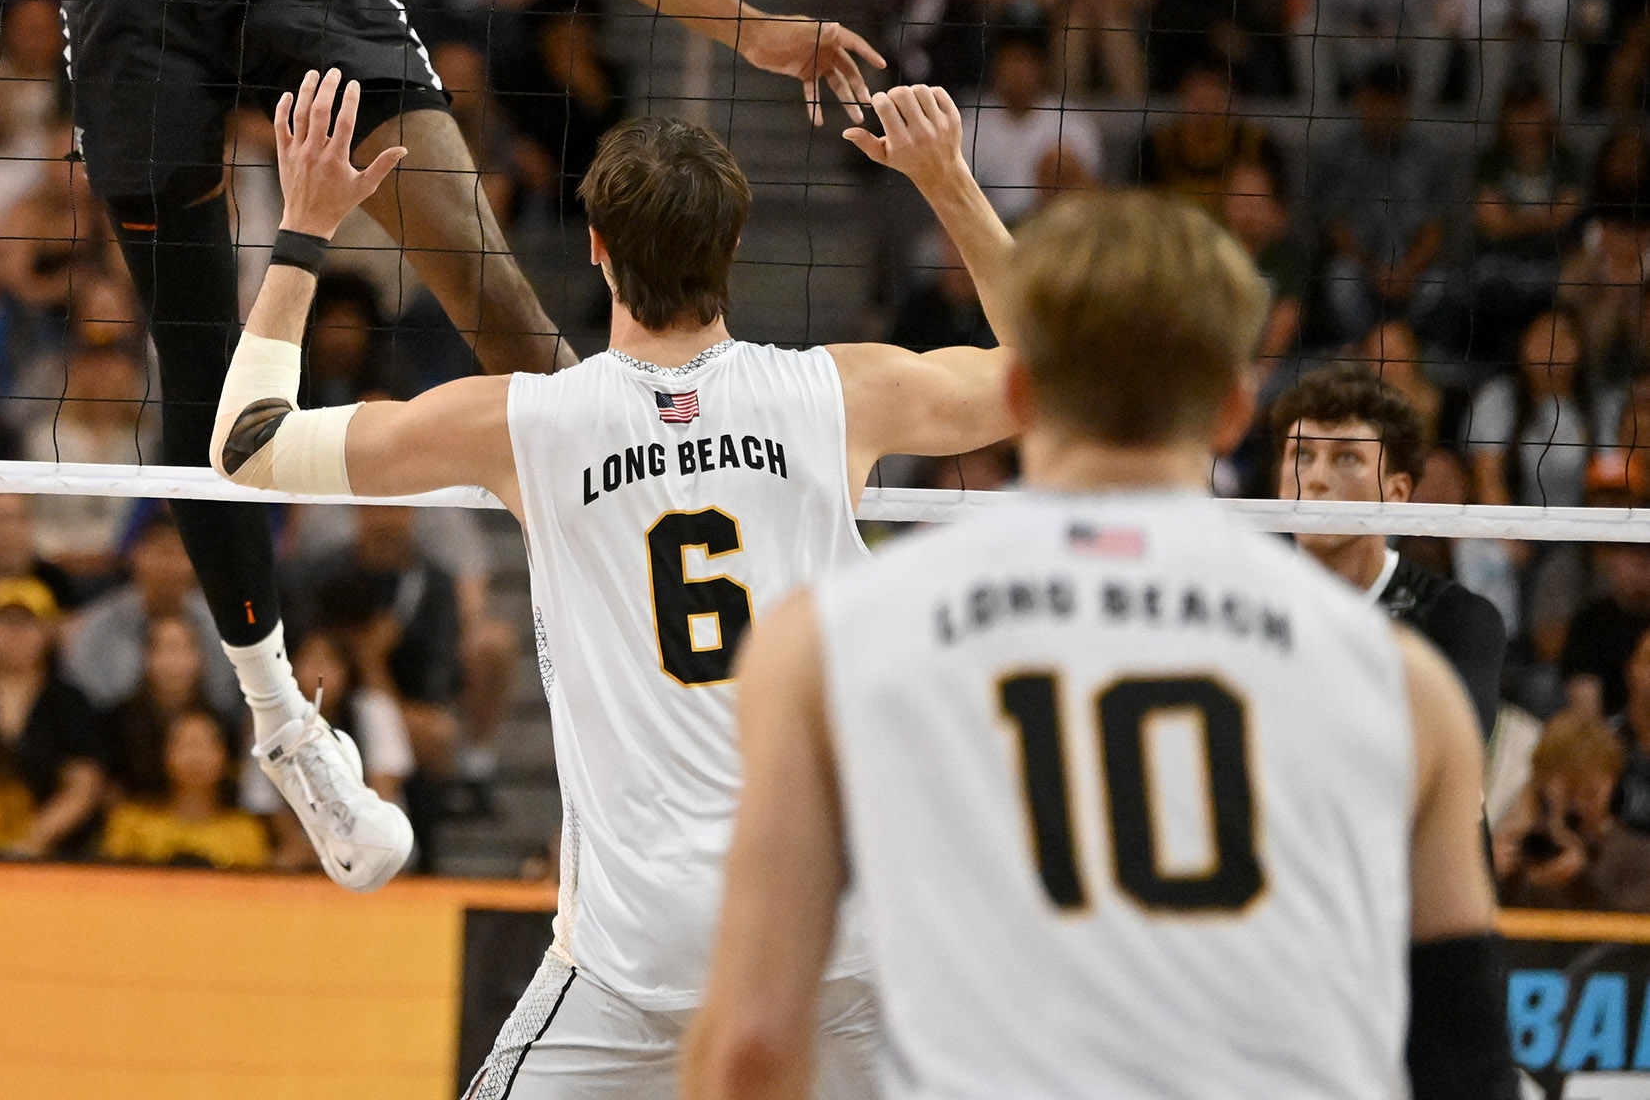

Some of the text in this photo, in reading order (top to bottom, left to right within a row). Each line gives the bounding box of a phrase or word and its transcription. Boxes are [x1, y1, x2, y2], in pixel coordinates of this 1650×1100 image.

[583, 434, 788, 506] LONG BEACH
[644, 504, 757, 689] 6
[934, 580, 1293, 652] LONG BEACH
[994, 668, 1270, 918] 10
[1505, 967, 1650, 1073] BA
